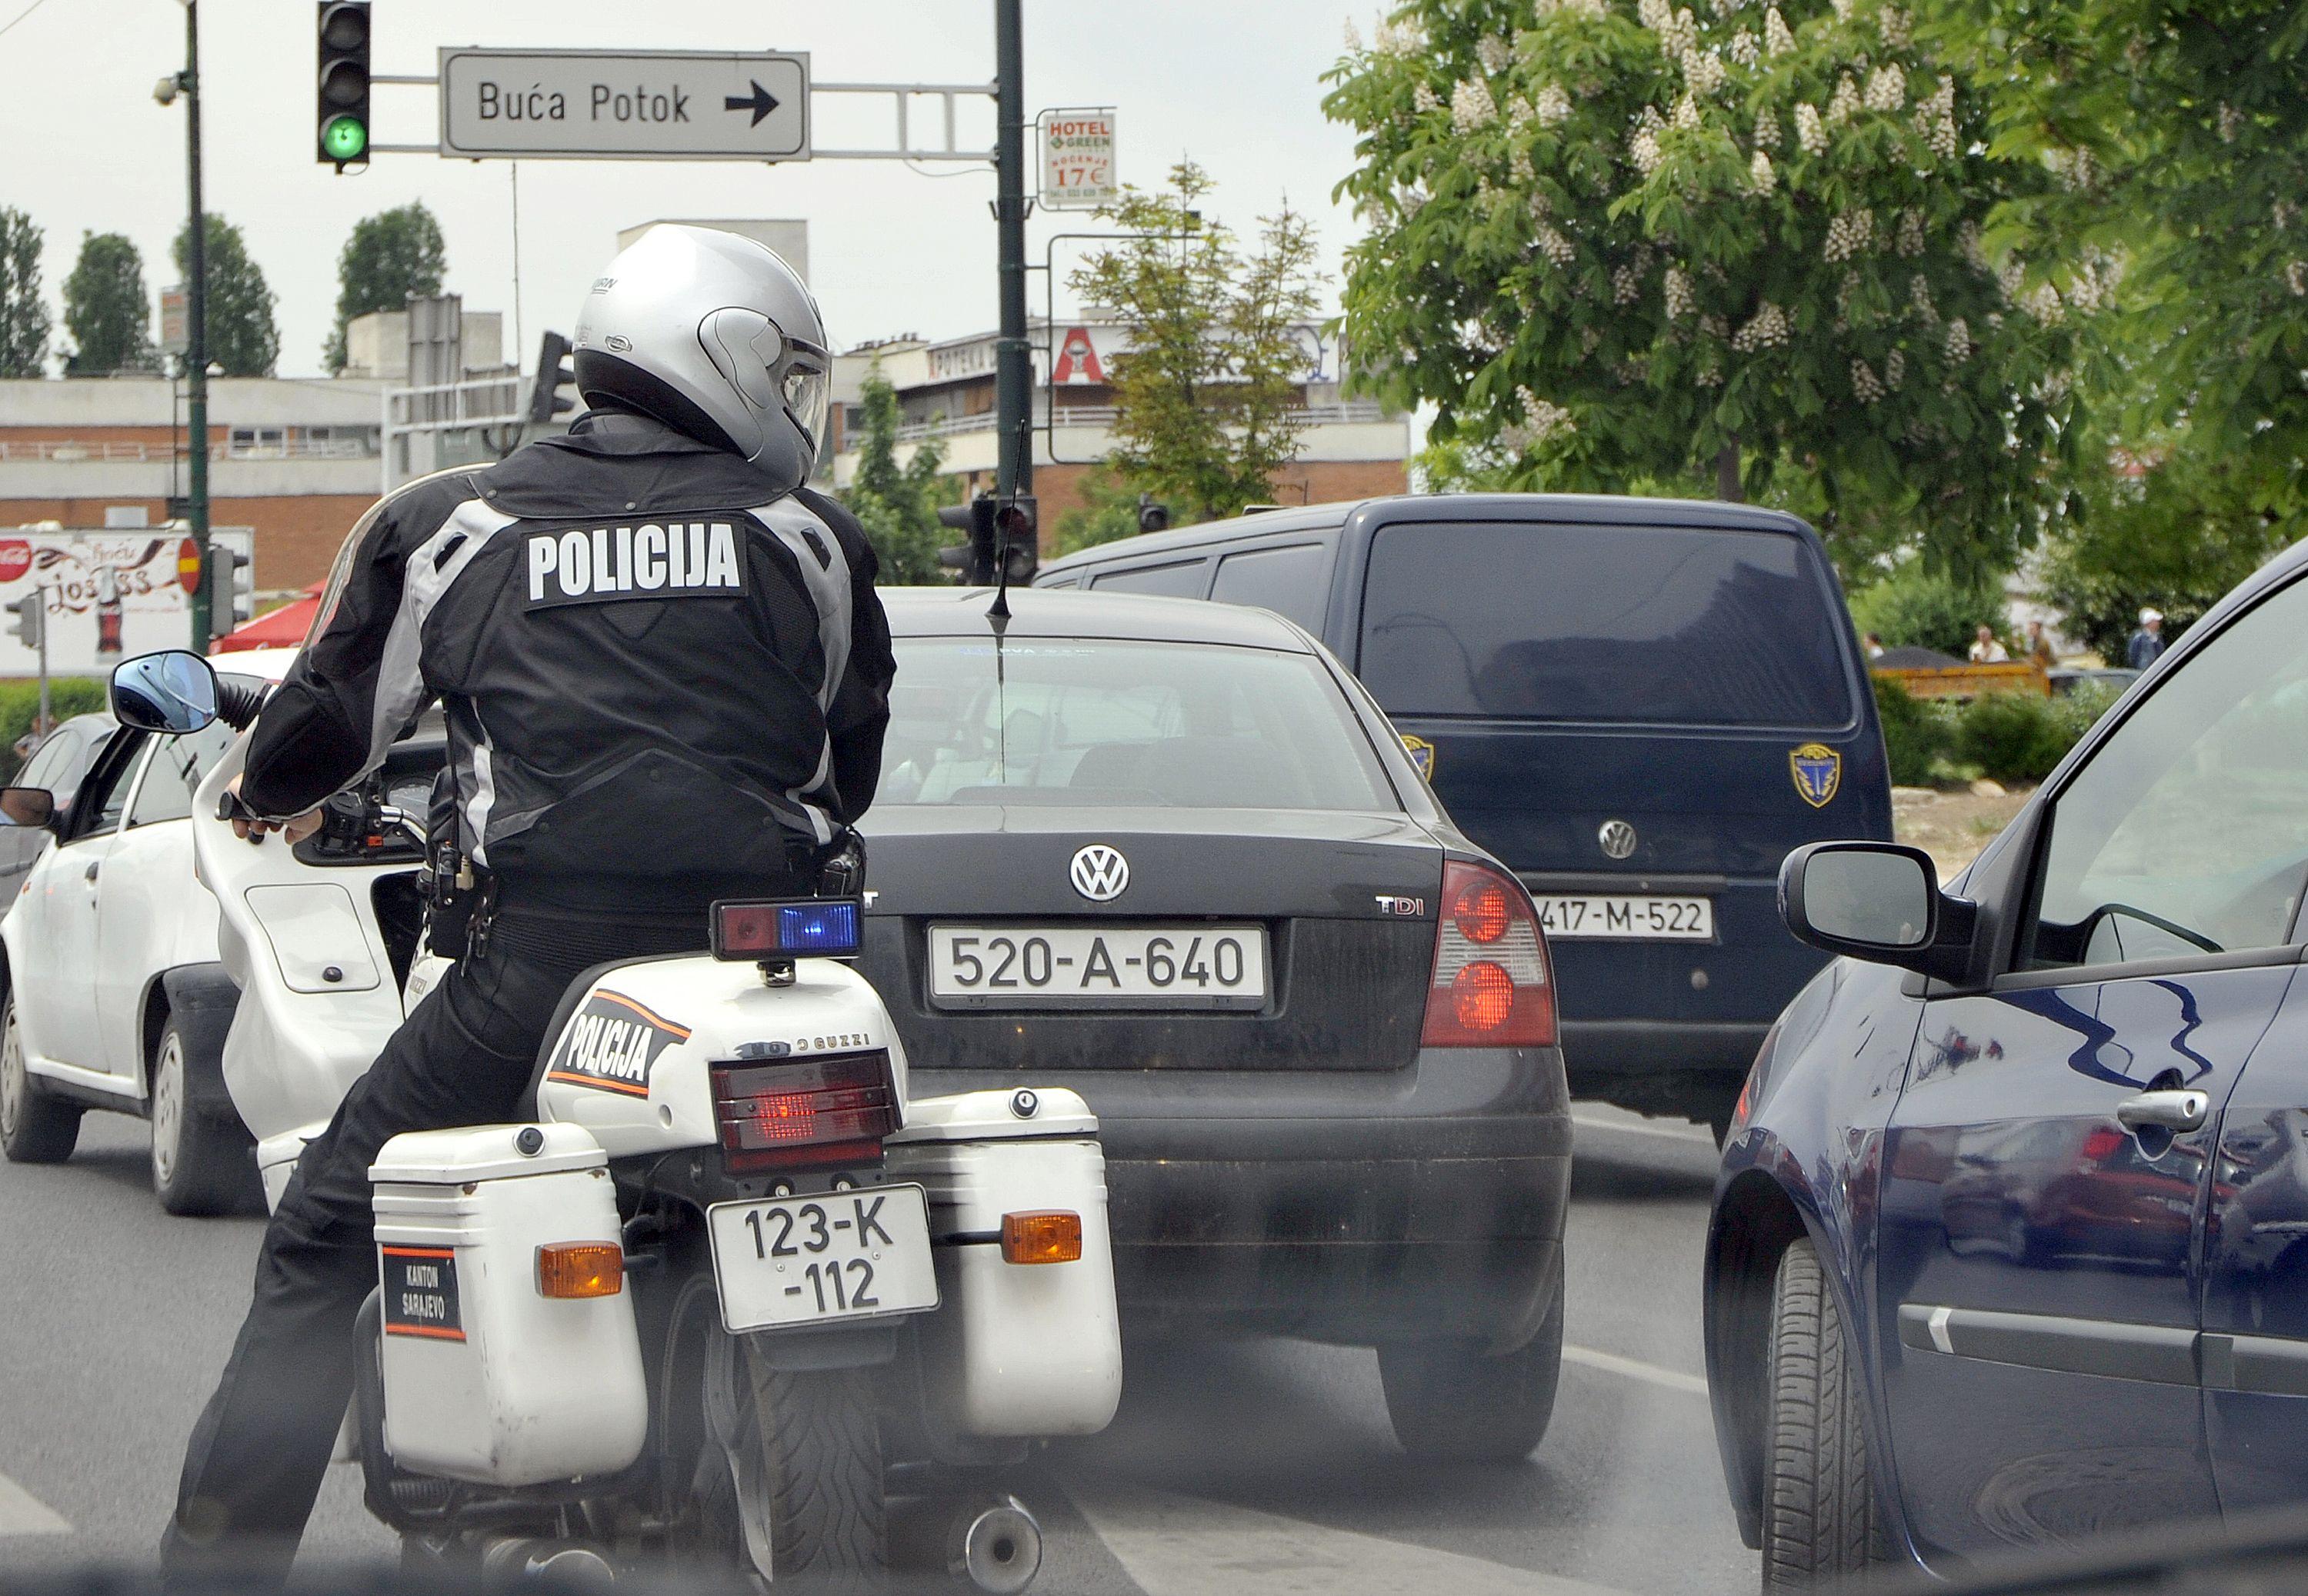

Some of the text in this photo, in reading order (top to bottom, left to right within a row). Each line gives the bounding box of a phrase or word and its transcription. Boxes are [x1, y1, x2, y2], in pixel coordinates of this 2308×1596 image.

[479, 81, 690, 122] Buća Potok
[1050, 122, 1109, 136] HOTEL
[1066, 137, 1110, 148] GREEN
[529, 522, 741, 601] POLICIJA
[1375, 895, 1425, 916] TDI
[1540, 901, 1703, 932] 417-M-522
[952, 937, 1244, 987] 520-A-640
[565, 1013, 653, 1081] POLICIJA
[814, 1033, 870, 1050] GUZZI
[745, 1195, 894, 1259] 123-K
[406, 1264, 439, 1288] KANTON
[784, 1258, 879, 1312] -112
[402, 1292, 445, 1321] SARAJEVO
